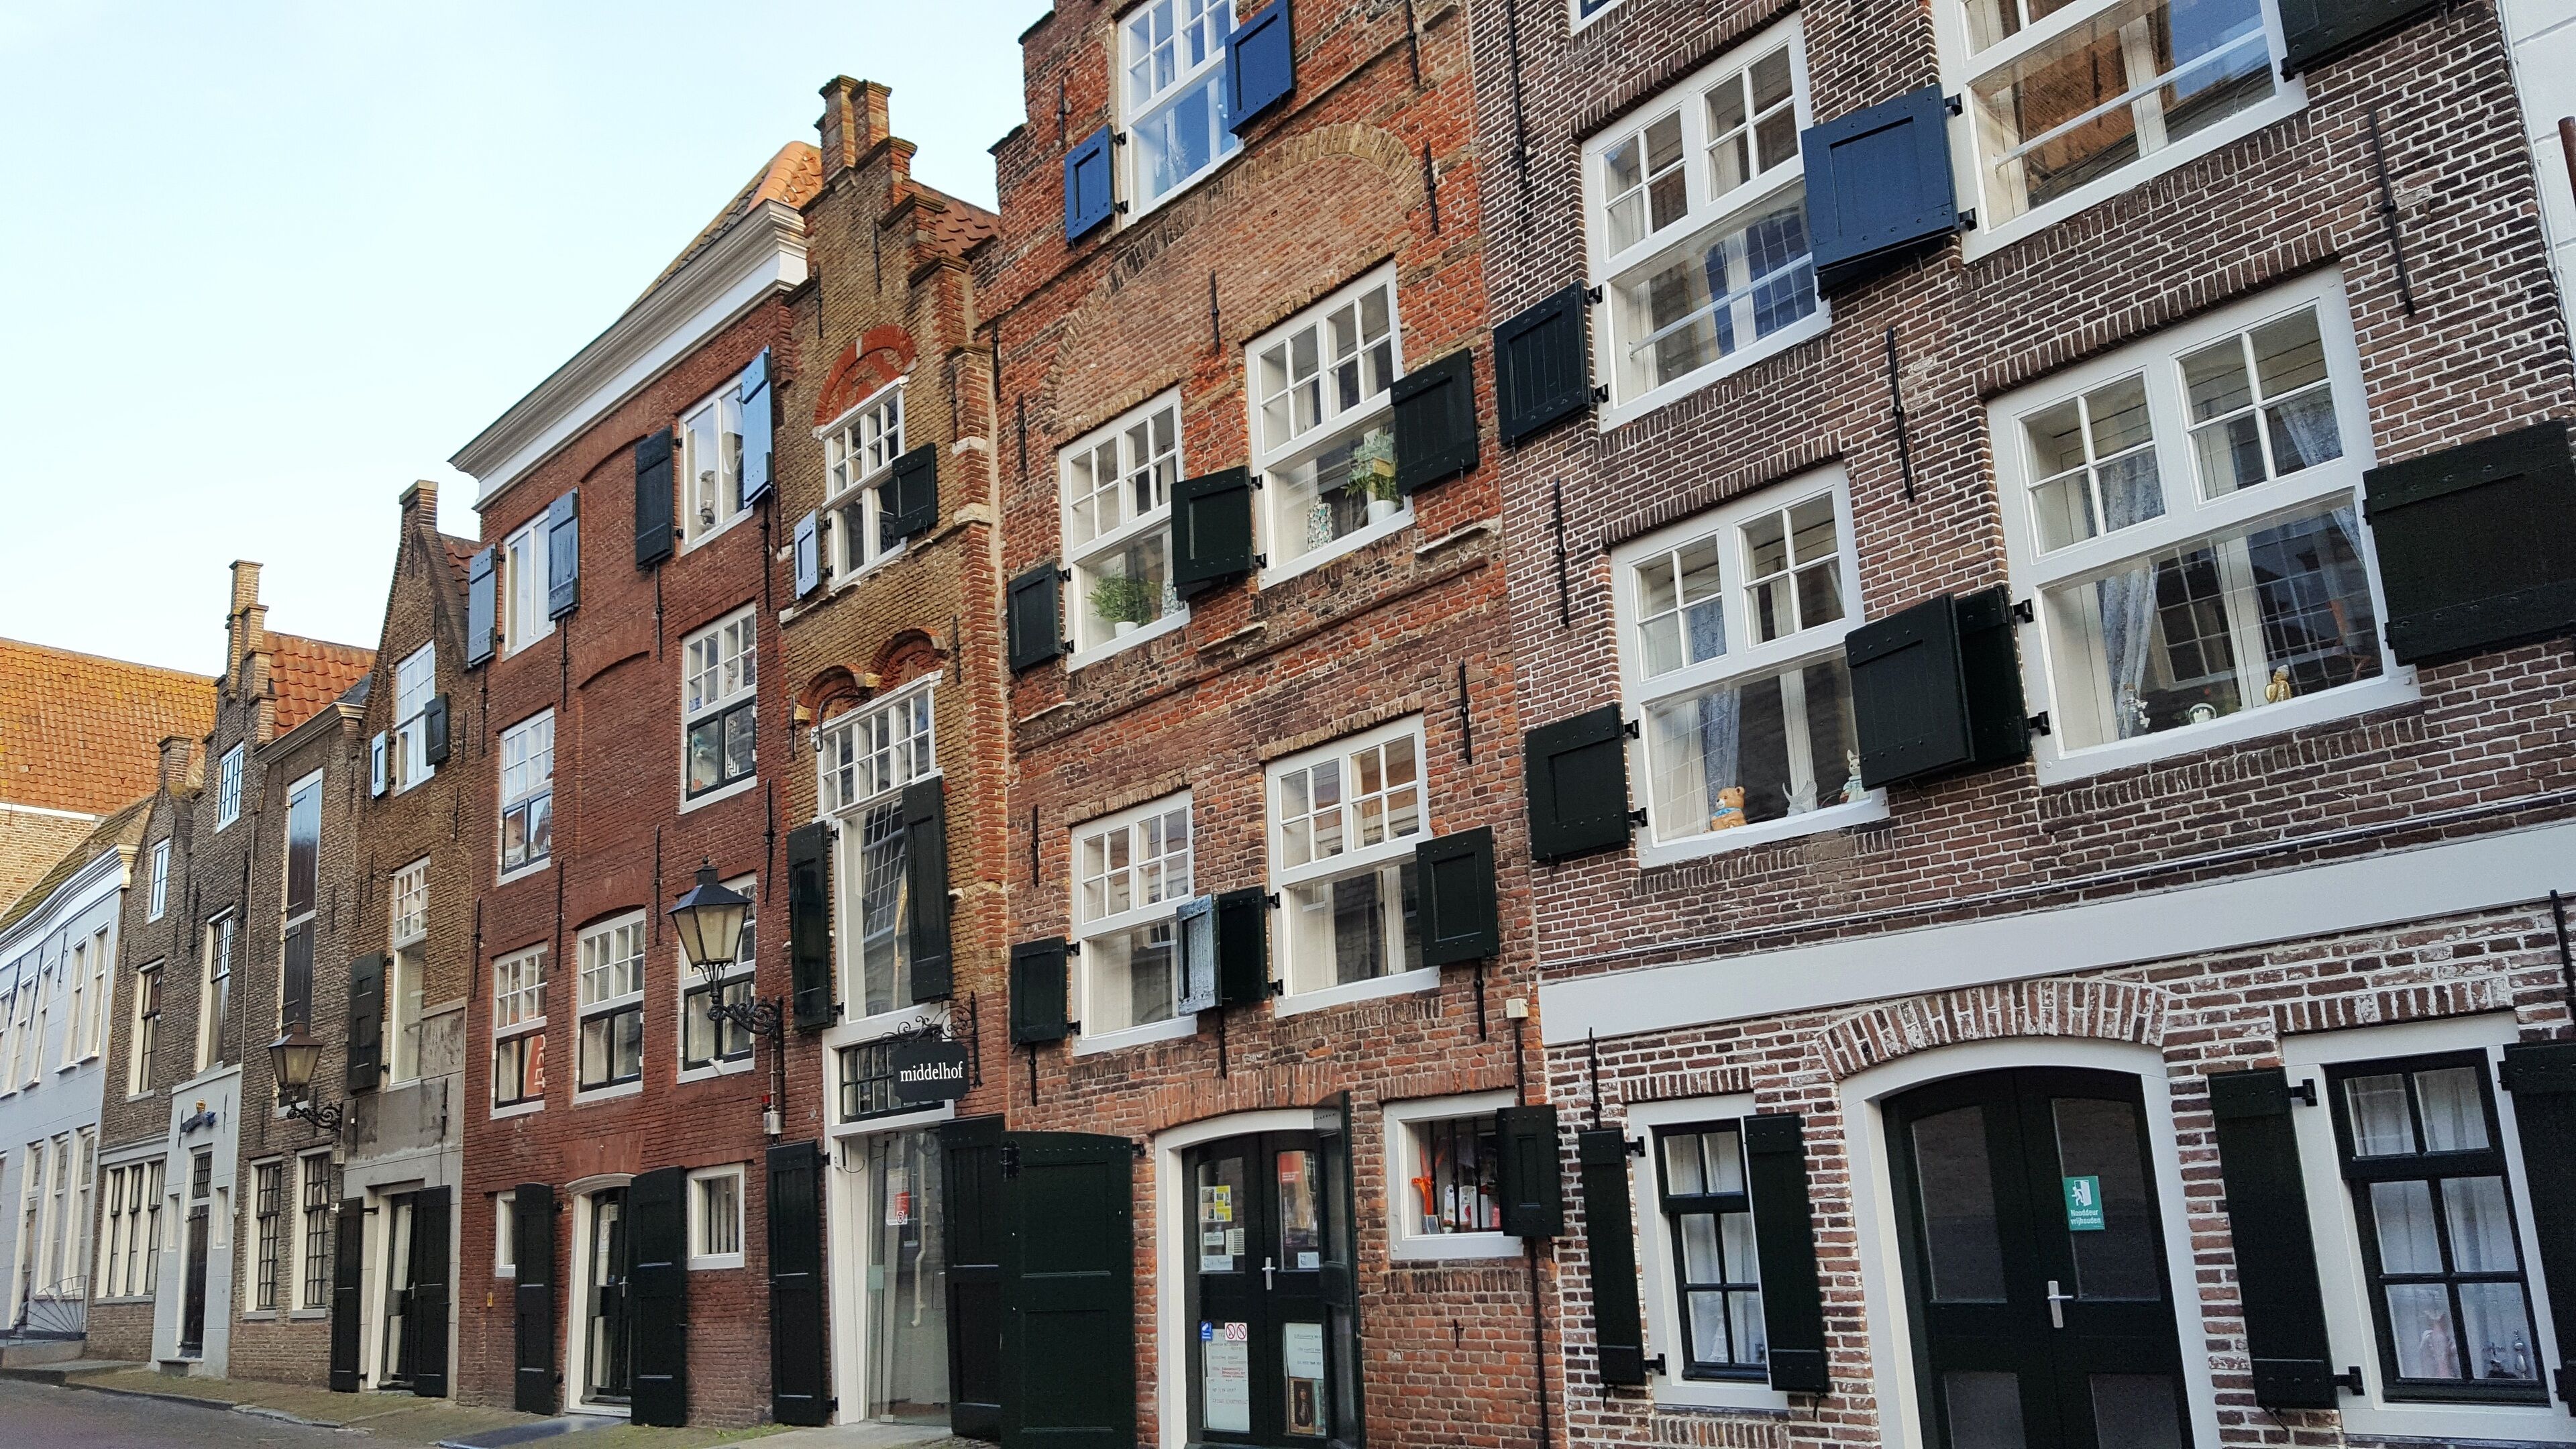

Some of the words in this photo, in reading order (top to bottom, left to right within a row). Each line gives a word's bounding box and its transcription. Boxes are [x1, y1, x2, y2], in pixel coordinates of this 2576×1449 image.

[900, 1061, 963, 1082] middelhof
[2070, 1209, 2098, 1217] Nooddeur
[2070, 1217, 2101, 1226] vrijhouden
